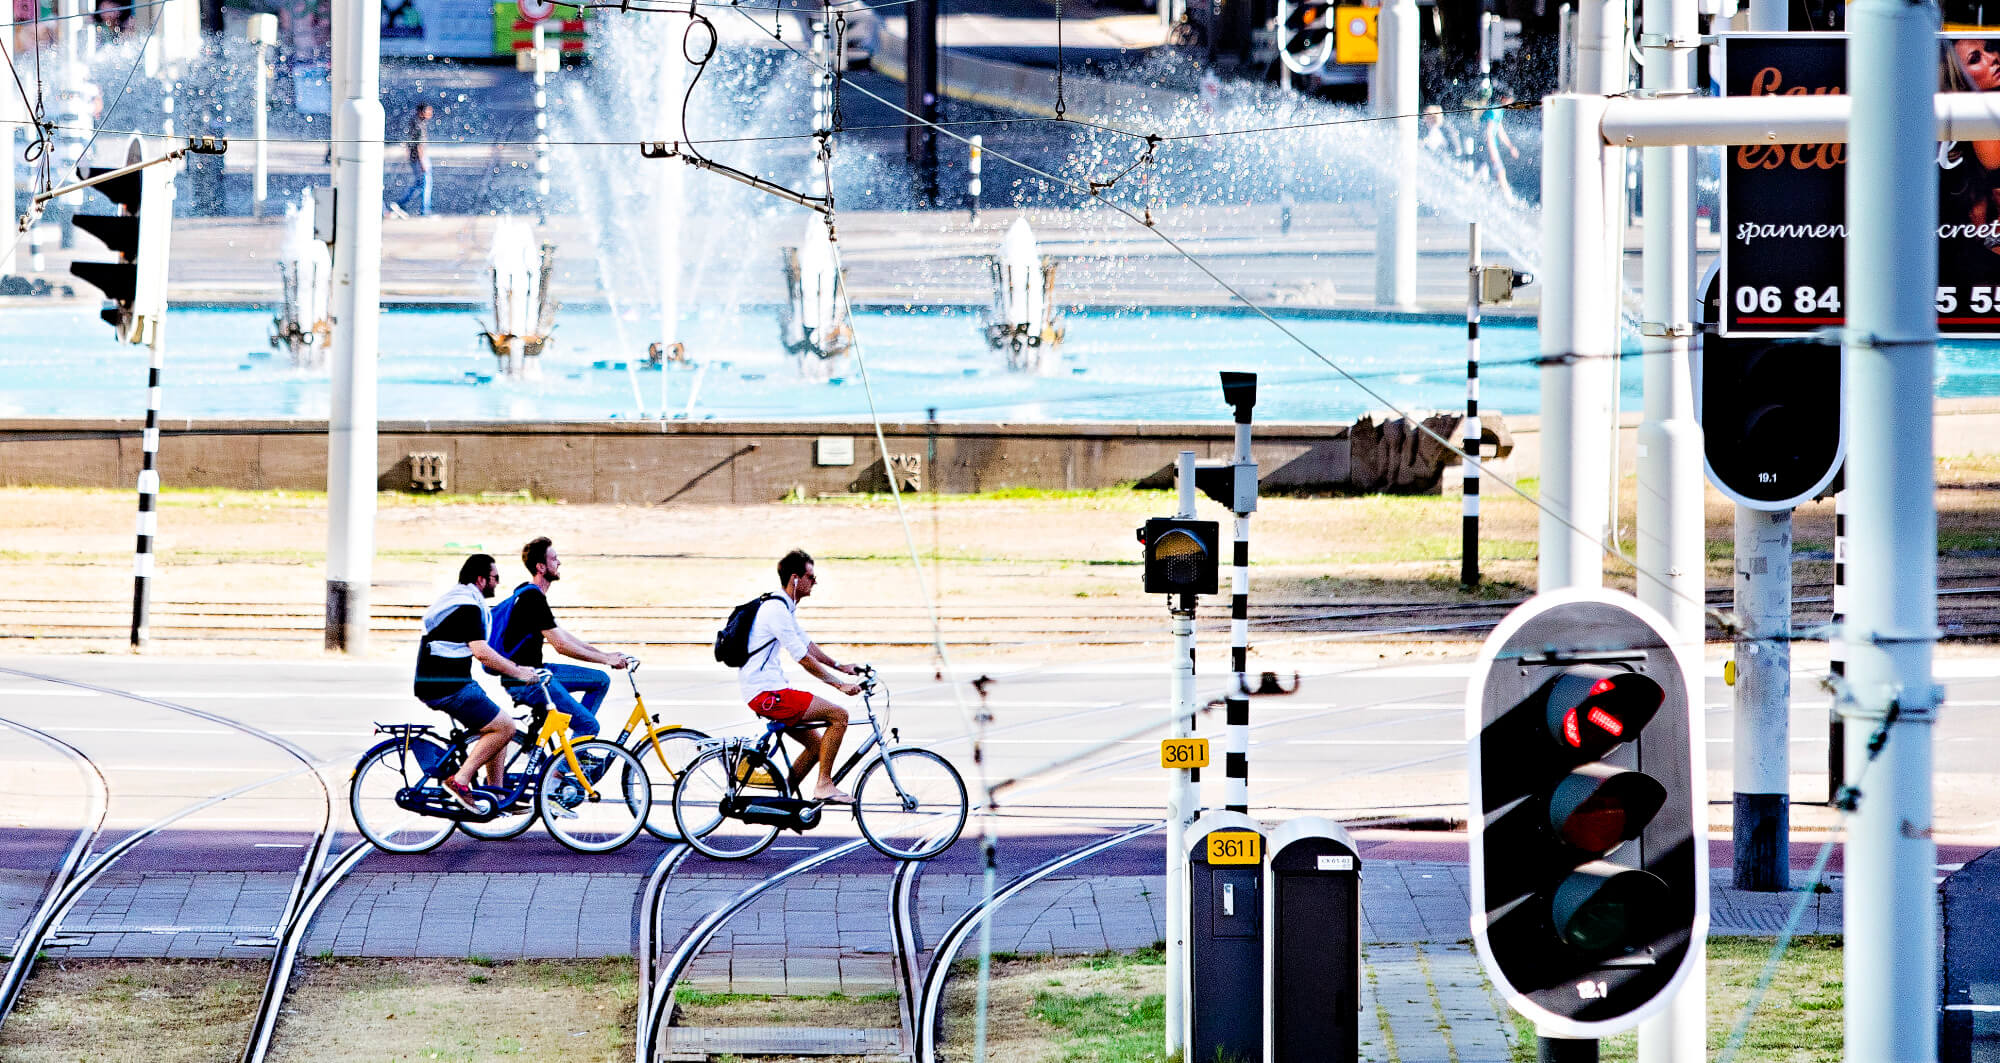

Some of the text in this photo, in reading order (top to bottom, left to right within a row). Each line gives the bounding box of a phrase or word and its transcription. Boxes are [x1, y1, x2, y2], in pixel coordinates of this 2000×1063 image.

[1737, 143, 1848, 170] esco
[1736, 219, 2000, 246] spannen creet
[1736, 286, 1782, 313] 06
[1794, 286, 1841, 313] 84
[1934, 286, 1958, 314] 5
[1758, 472, 1777, 483] 19.1
